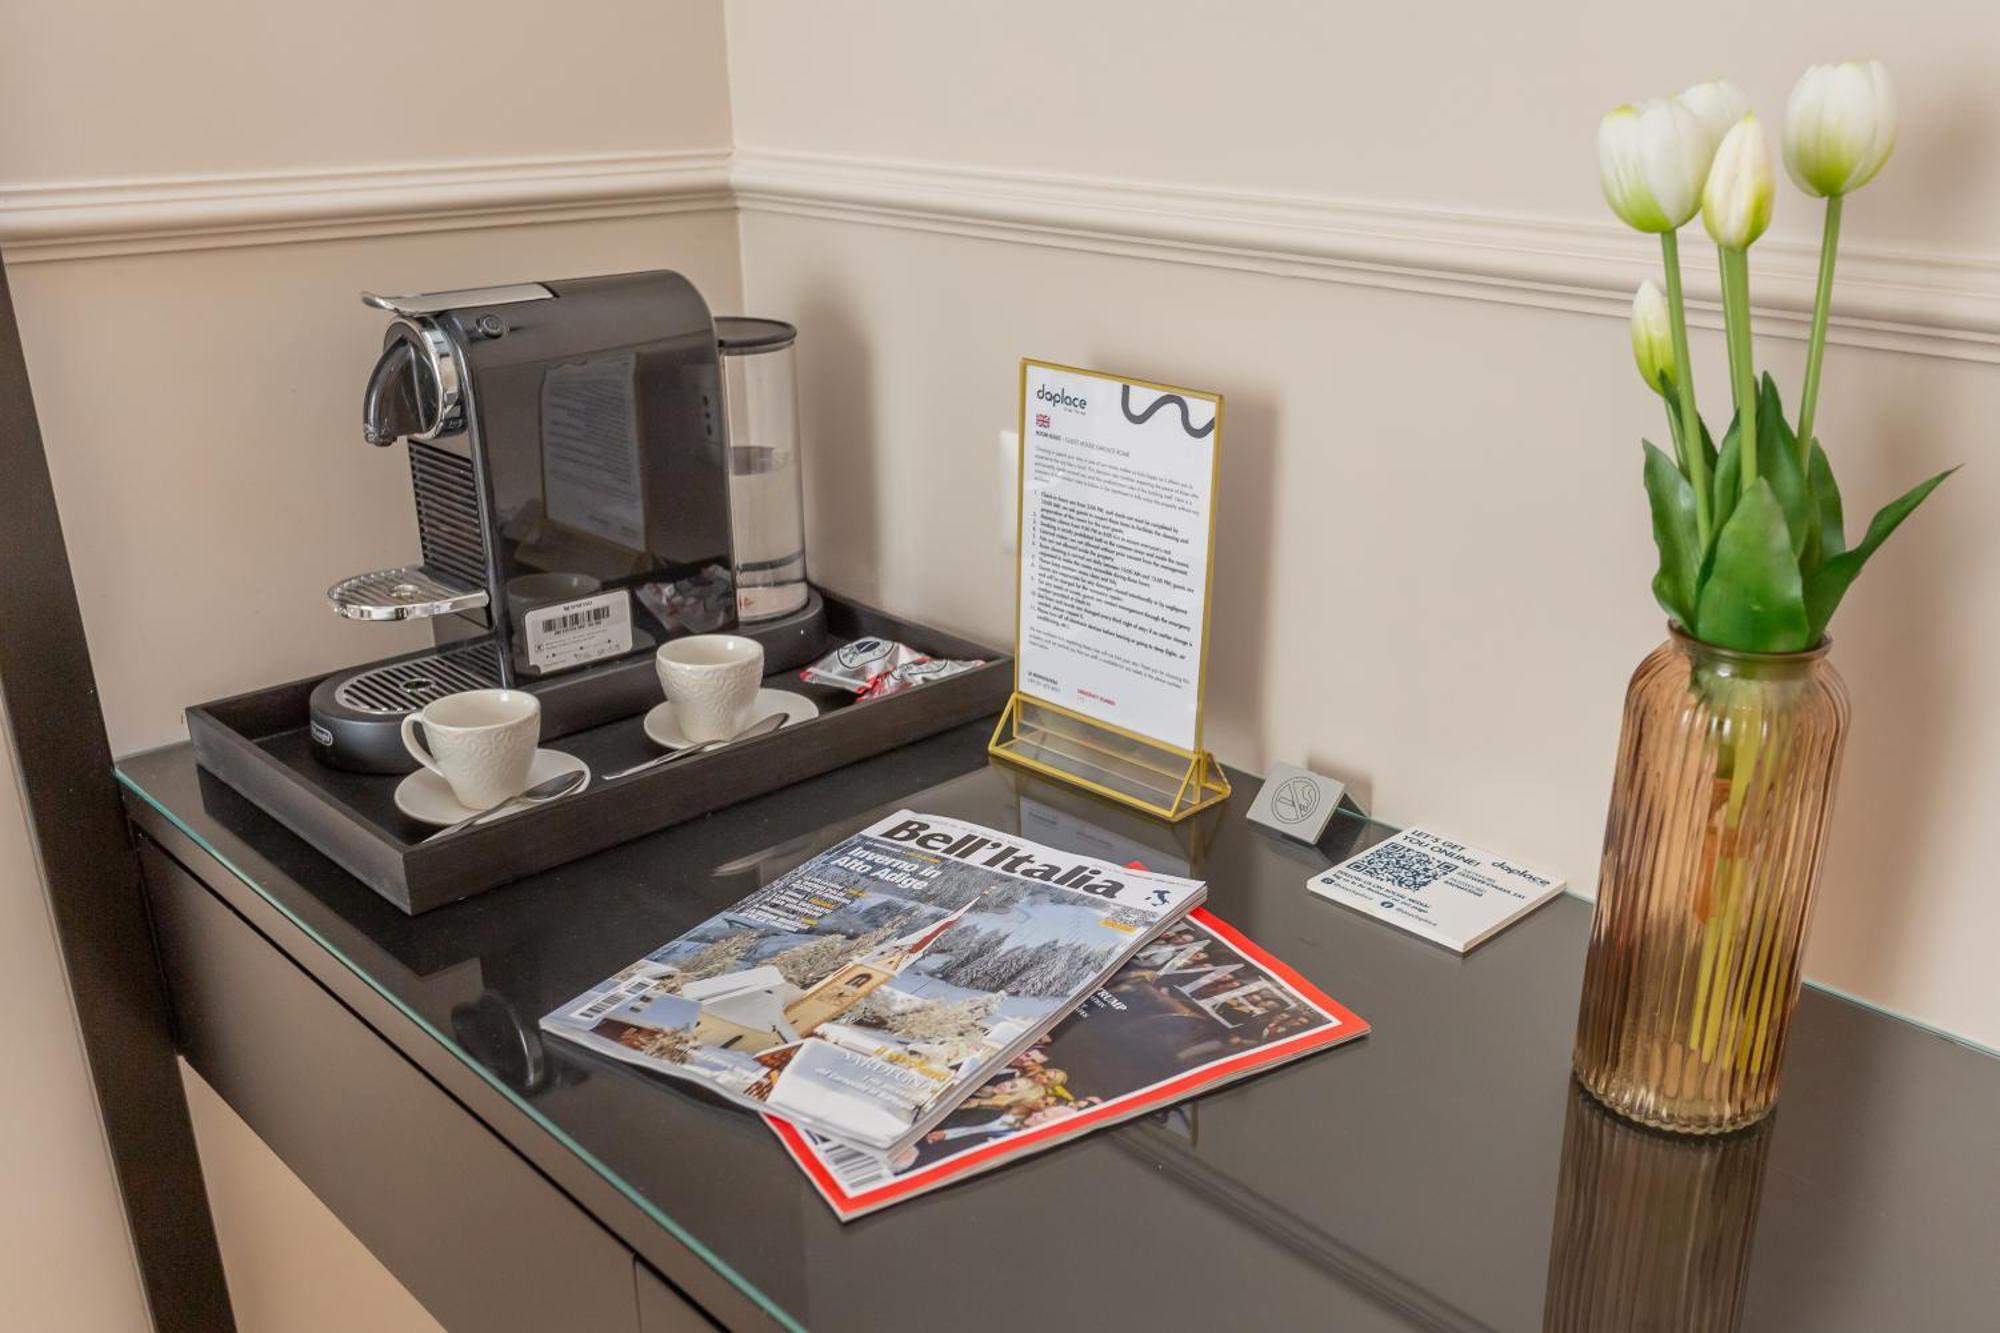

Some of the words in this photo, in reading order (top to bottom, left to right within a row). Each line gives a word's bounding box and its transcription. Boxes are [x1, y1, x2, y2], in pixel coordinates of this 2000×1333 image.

[1036, 383, 1087, 410] daplace
[1403, 835, 1430, 848] YOU
[1430, 845, 1481, 867] ONLINE!
[1411, 829, 1439, 843] LET'S
[1441, 839, 1467, 851] GET
[830, 856, 872, 874] Alto
[871, 865, 929, 890] Adige
[848, 846, 920, 873] Inverno
[921, 865, 943, 879] in
[879, 819, 1125, 899] Bell'Italia
[1491, 860, 1551, 887] daplace
